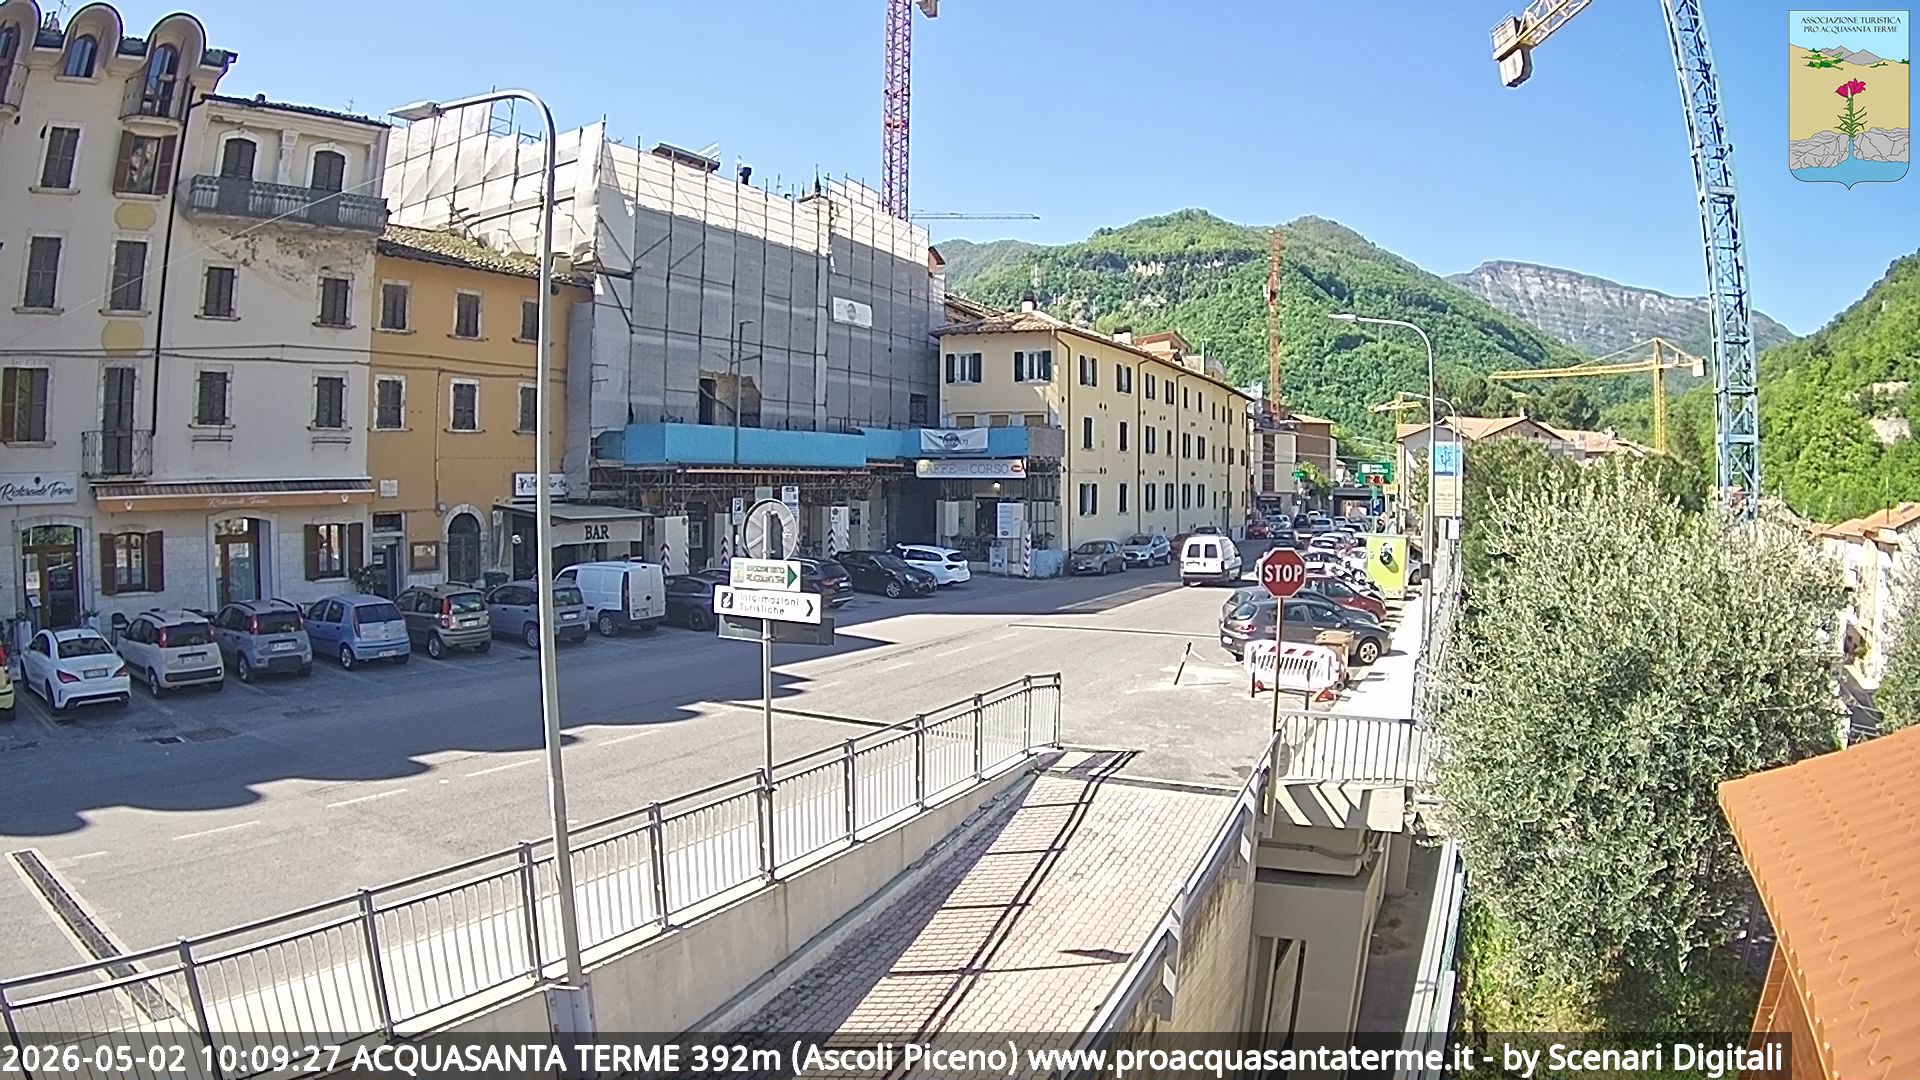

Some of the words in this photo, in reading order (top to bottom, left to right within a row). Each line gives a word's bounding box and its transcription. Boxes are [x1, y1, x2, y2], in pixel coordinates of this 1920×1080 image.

[584, 525, 610, 541] BAR
[1263, 564, 1303, 582] STOP
[740, 602, 786, 615] Turistiche
